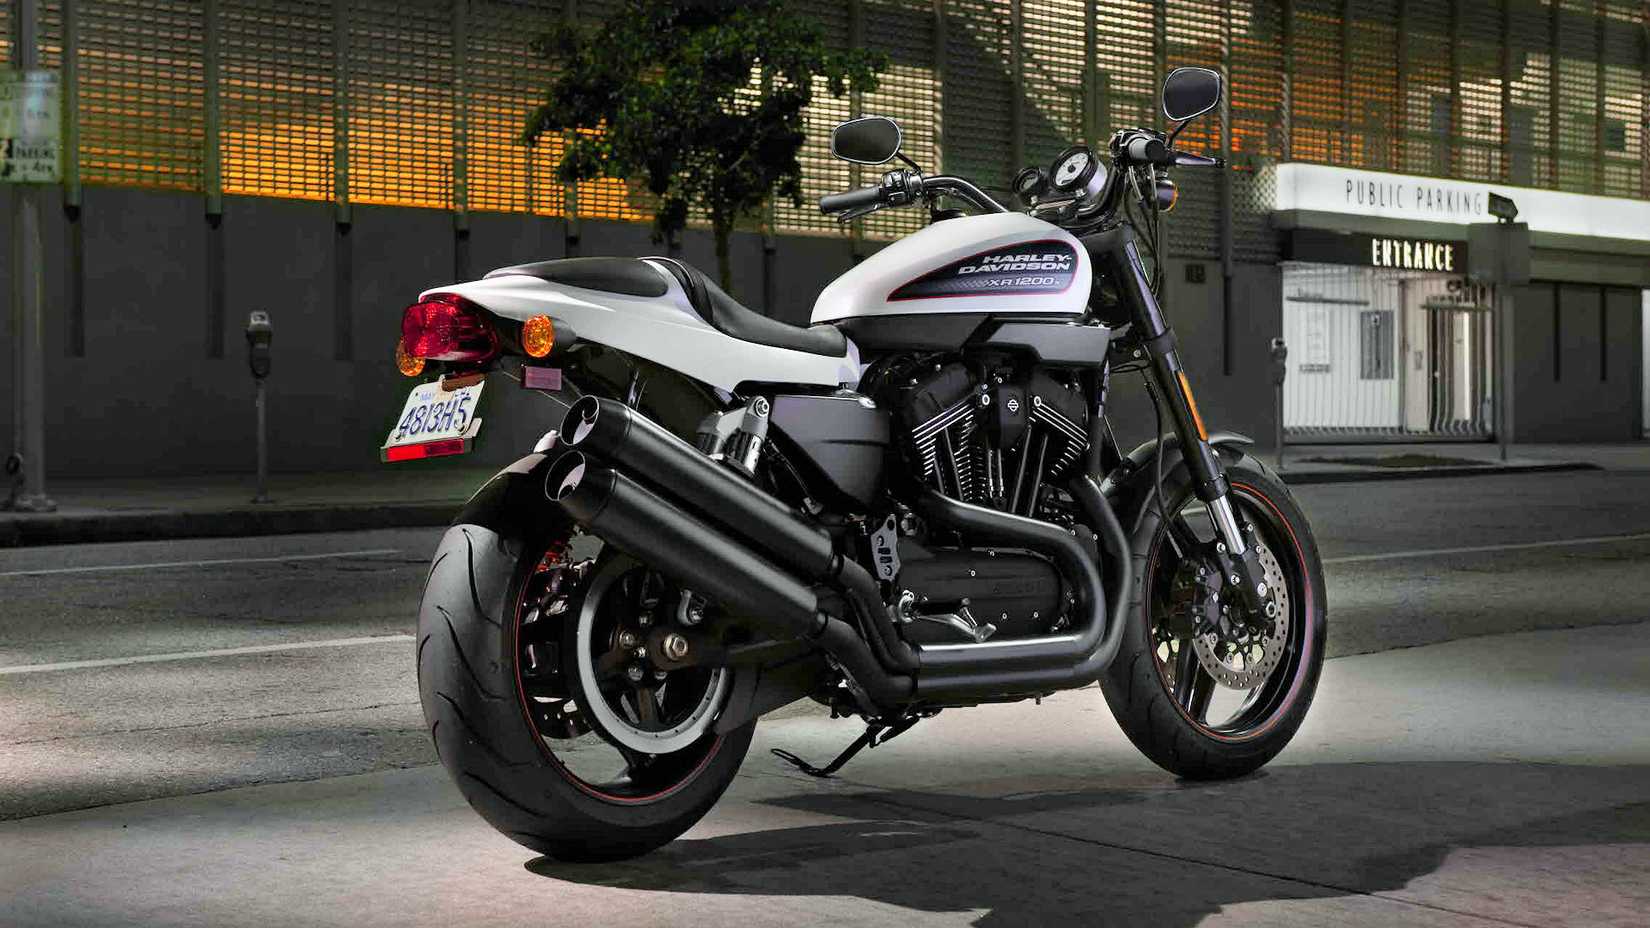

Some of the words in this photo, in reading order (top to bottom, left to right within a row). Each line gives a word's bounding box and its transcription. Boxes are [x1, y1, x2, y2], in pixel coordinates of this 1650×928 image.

[1347, 179, 1403, 208] PUBLIC
[1417, 187, 1481, 215] PARKING
[958, 262, 1070, 274] DAVIDSON
[1372, 238, 1454, 271] ENTRANCE
[399, 397, 471, 436] 4813H5
